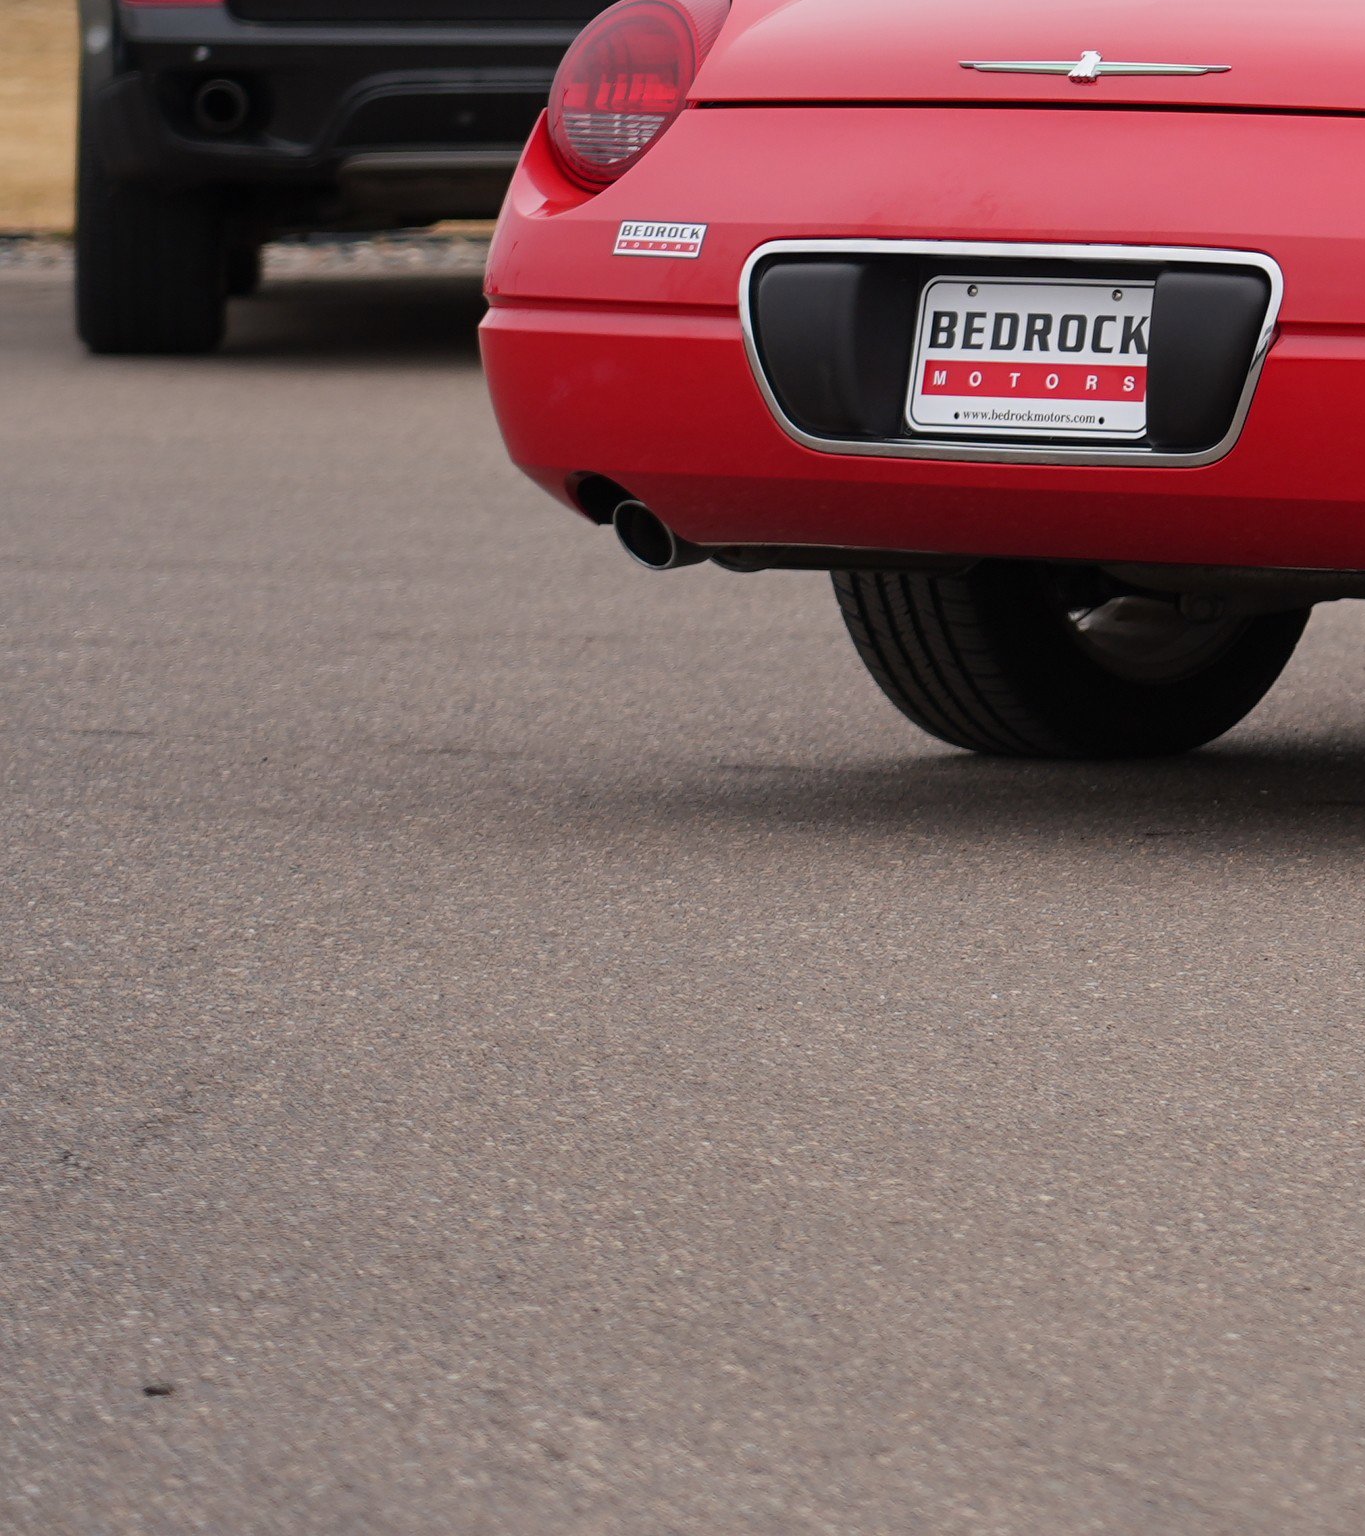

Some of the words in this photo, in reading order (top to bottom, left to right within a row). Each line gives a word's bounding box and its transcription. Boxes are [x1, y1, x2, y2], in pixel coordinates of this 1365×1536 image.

[620, 224, 702, 240] BEDROCK
[619, 241, 696, 252] MOTORS
[928, 311, 1150, 355] BEDROCK
[932, 370, 1136, 393] MOTORS
[962, 409, 1096, 425] www.bedrockmotors.com
